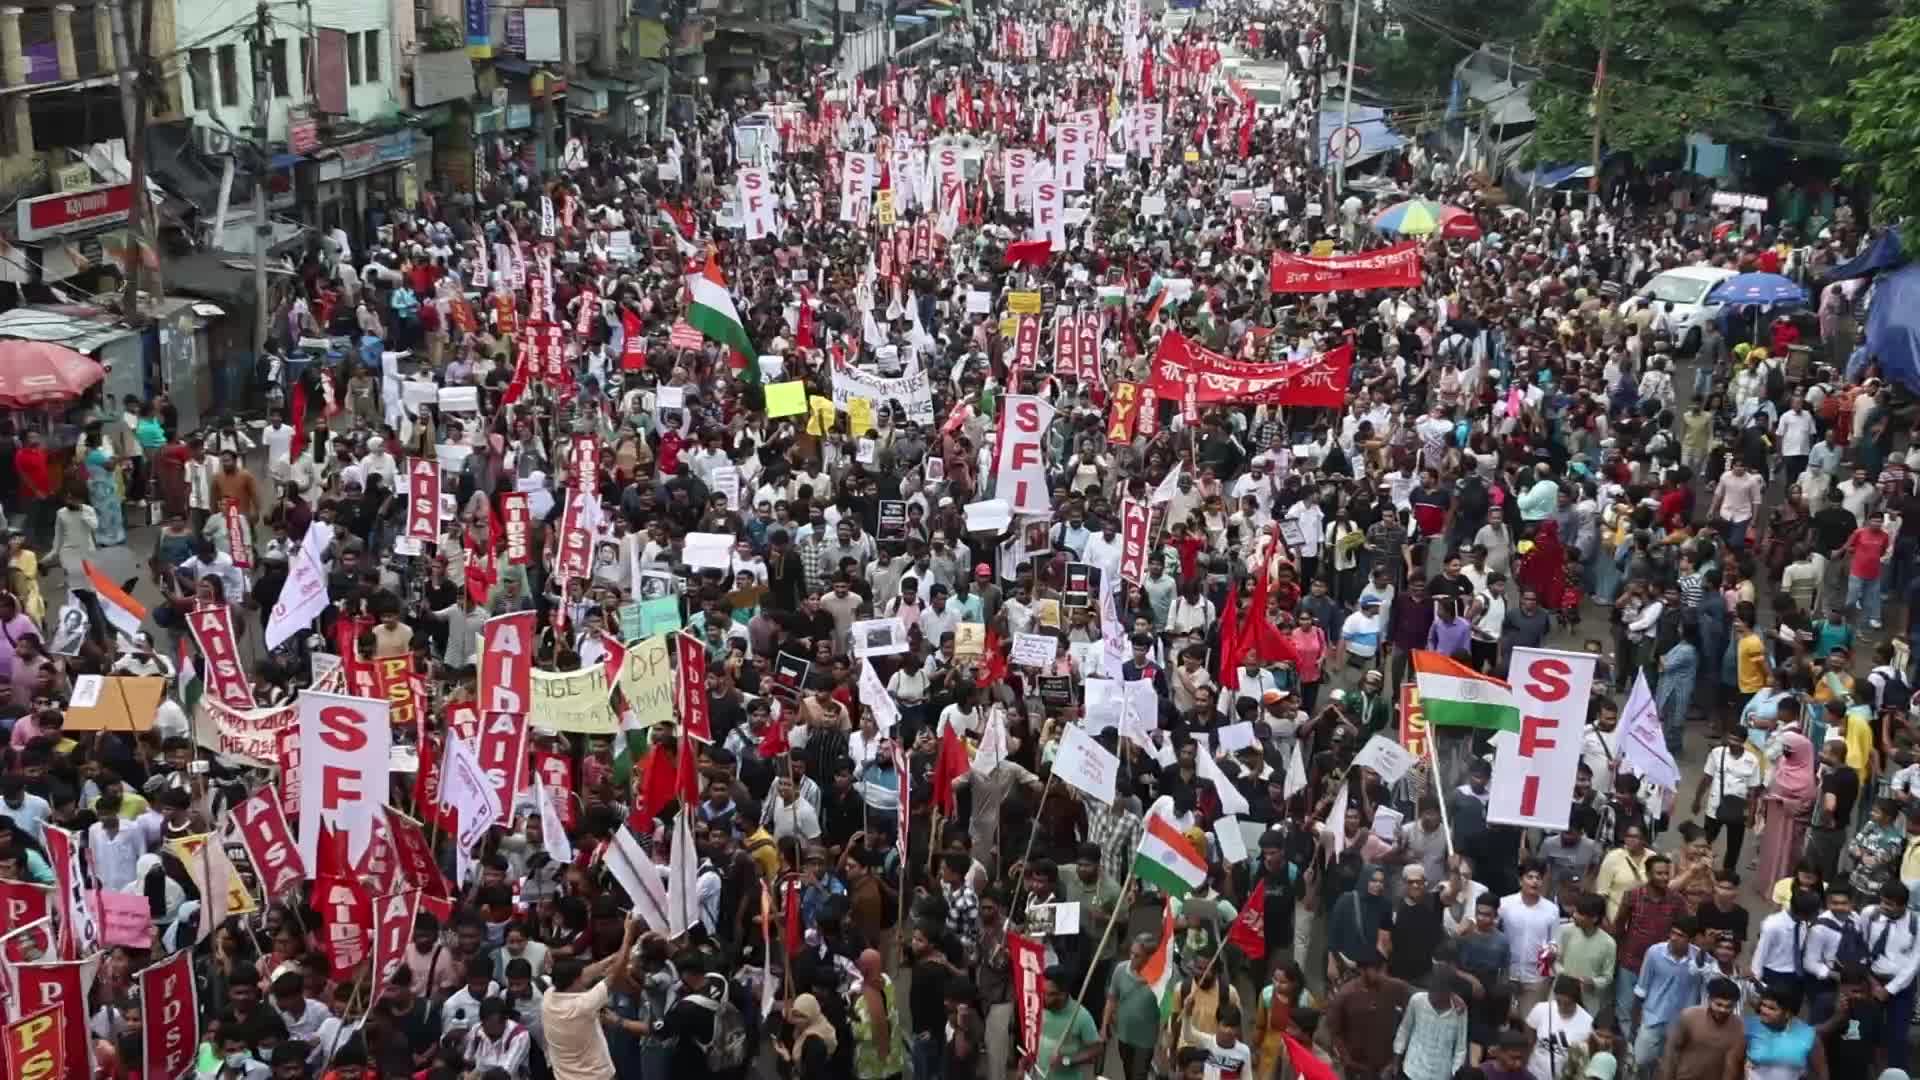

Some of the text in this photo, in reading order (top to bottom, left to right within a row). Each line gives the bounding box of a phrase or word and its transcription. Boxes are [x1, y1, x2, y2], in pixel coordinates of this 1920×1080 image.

[850, 158, 866, 217] SFI
[1011, 153, 1025, 209] SFI
[1062, 128, 1078, 187] SFI
[744, 173, 764, 235] SFI
[1059, 316, 1074, 368] AISA
[1109, 383, 1135, 440] RYA
[1012, 403, 1041, 507] SFI
[411, 460, 434, 534] AISA
[1122, 506, 1144, 576] AISA
[202, 612, 247, 700] AISA
[688, 645, 702, 724] PDSF
[319, 706, 368, 810] SF
[1519, 658, 1574, 817] SFI
[246, 797, 301, 892] AISA
[162, 973, 183, 1074] PDSF
